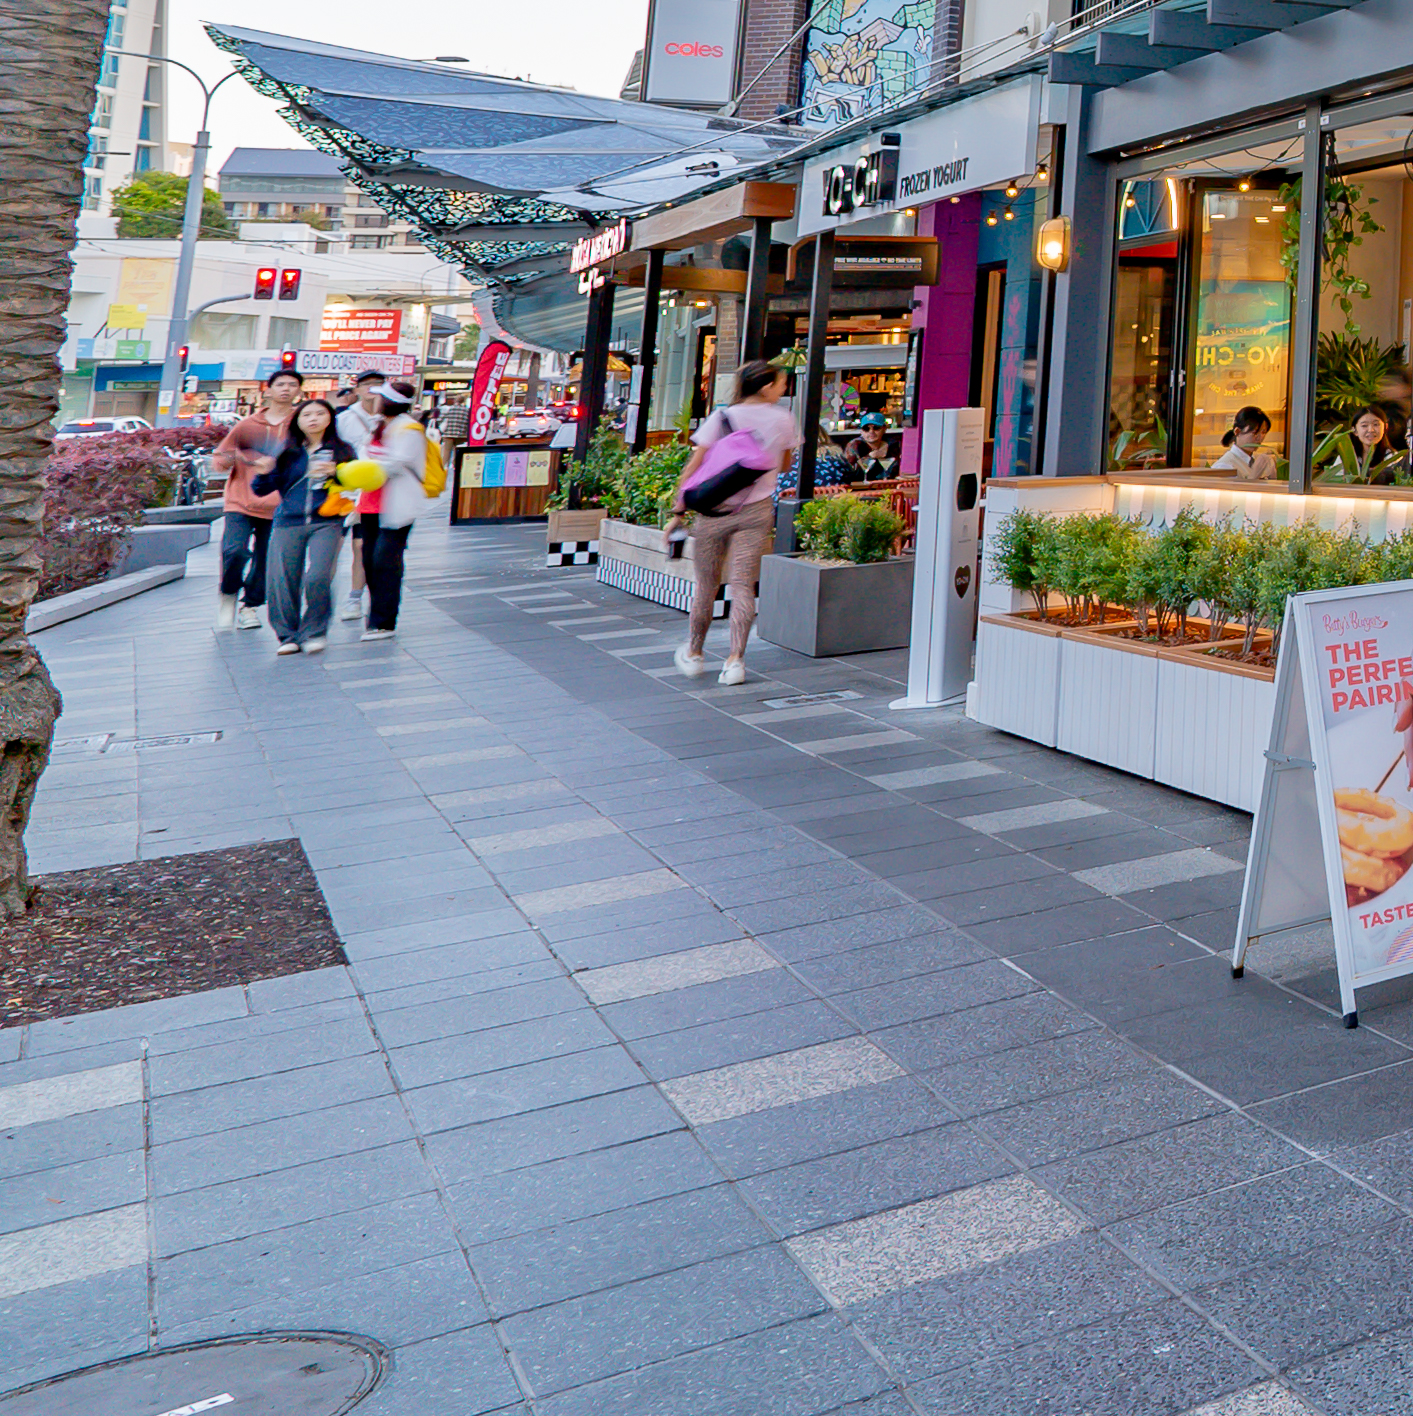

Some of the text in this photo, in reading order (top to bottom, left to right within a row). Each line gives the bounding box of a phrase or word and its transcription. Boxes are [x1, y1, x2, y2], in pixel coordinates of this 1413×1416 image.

[664, 41, 724, 58] coles
[899, 168, 931, 199] FROZEN
[932, 157, 970, 189] YOGURT
[302, 353, 329, 369] GOLD
[331, 354, 355, 371] COAST
[471, 351, 510, 441] COFFEE
[1322, 610, 1389, 636] Betty's Burgers
[1325, 638, 1379, 665] THE
